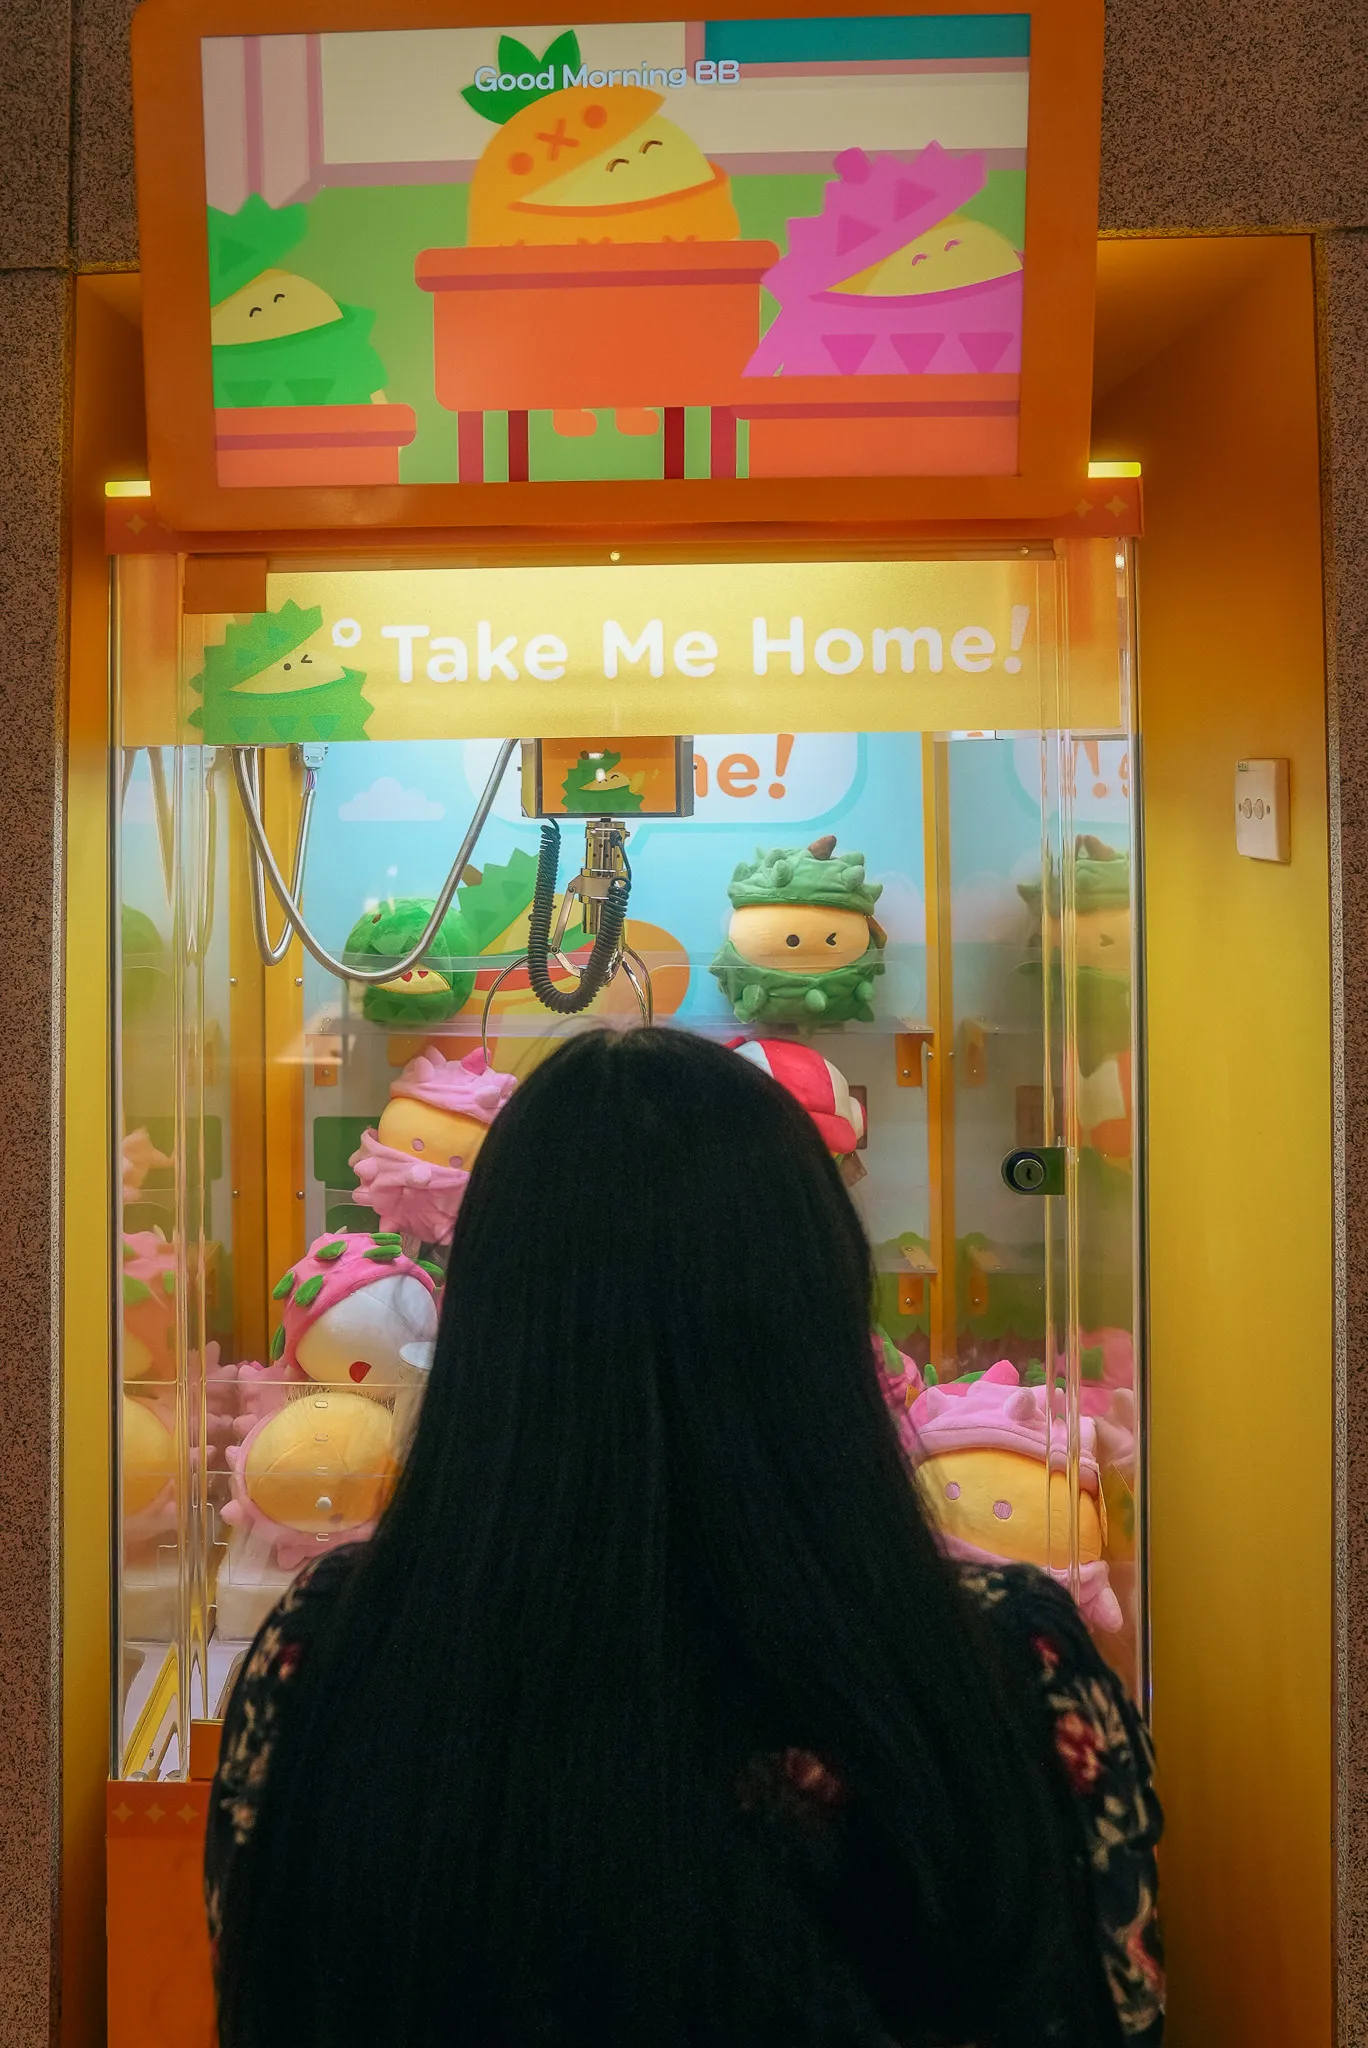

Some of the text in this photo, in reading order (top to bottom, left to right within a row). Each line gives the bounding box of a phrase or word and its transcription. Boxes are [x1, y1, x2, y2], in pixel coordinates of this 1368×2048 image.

[474, 59, 741, 92] Good Morning BB
[381, 605, 1030, 684] Take Me Home!
